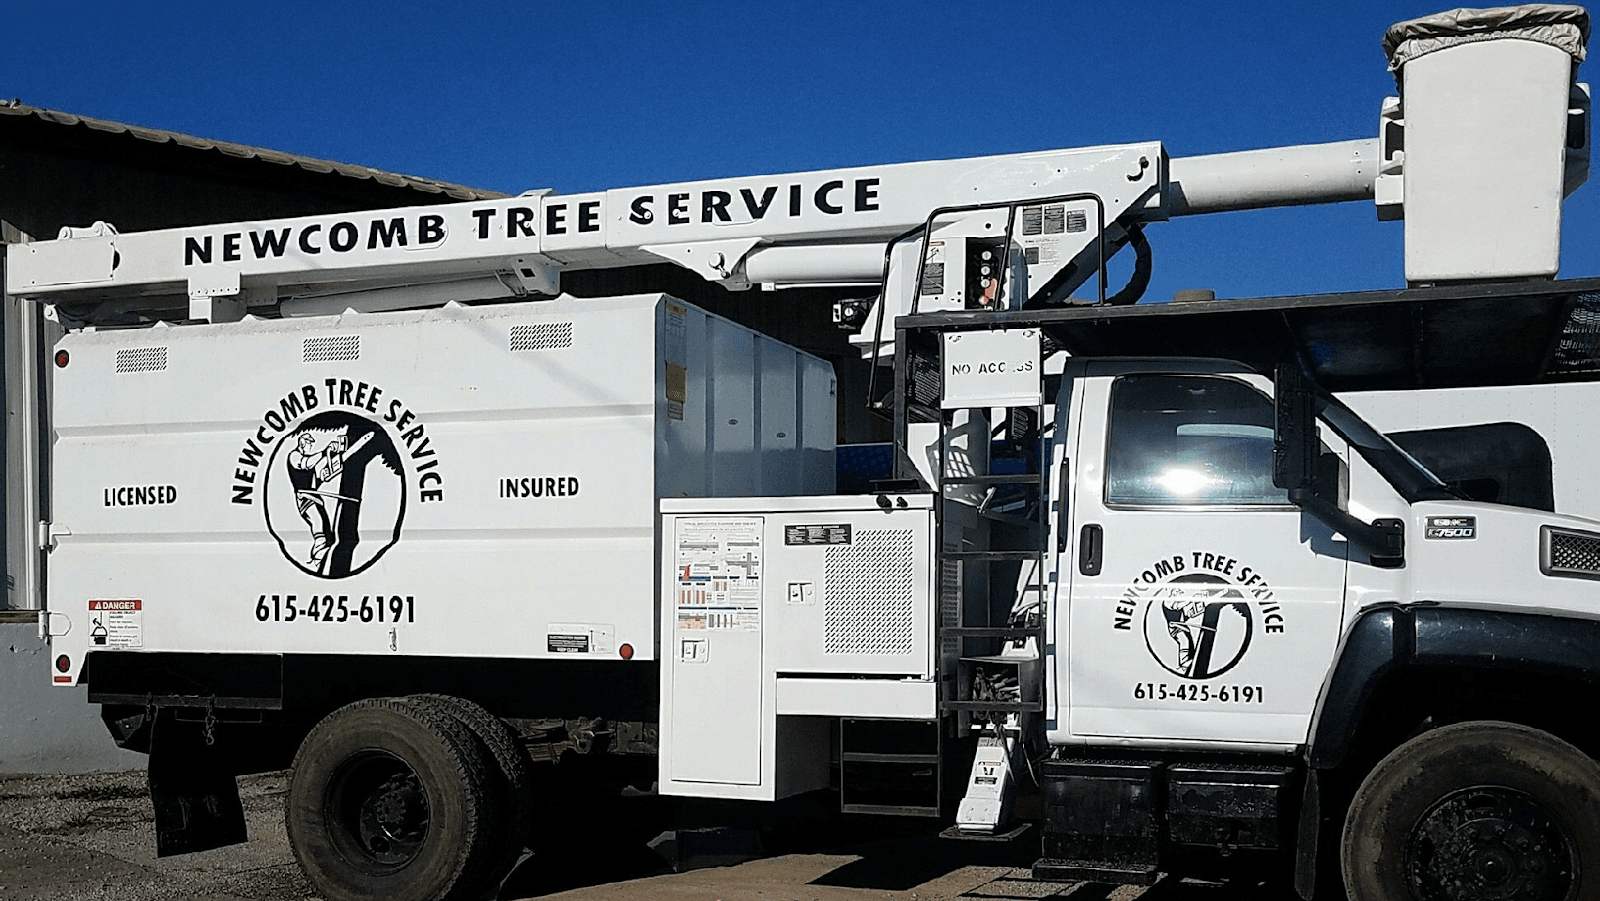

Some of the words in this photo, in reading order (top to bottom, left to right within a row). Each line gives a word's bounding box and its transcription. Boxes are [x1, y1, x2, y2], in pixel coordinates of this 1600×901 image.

[184, 214, 445, 266] NEWCOMB
[472, 201, 601, 240] TREE
[629, 177, 881, 226] SERVICE
[952, 364, 970, 375] NO
[978, 360, 1033, 374] ACCS
[231, 384, 319, 505] NEWCOMB
[324, 378, 382, 414] TREE
[383, 399, 443, 503] SERVICE
[104, 485, 177, 507] LICENSED
[500, 476, 579, 499] INSURED
[1114, 556, 1185, 631] NEWCOMB
[1192, 551, 1238, 576] TREE
[1236, 567, 1284, 634] SERVICE
[102, 602, 136, 610] DANGER
[256, 594, 415, 623] 615-425-6191
[1134, 682, 1263, 703] 615-425-6191
